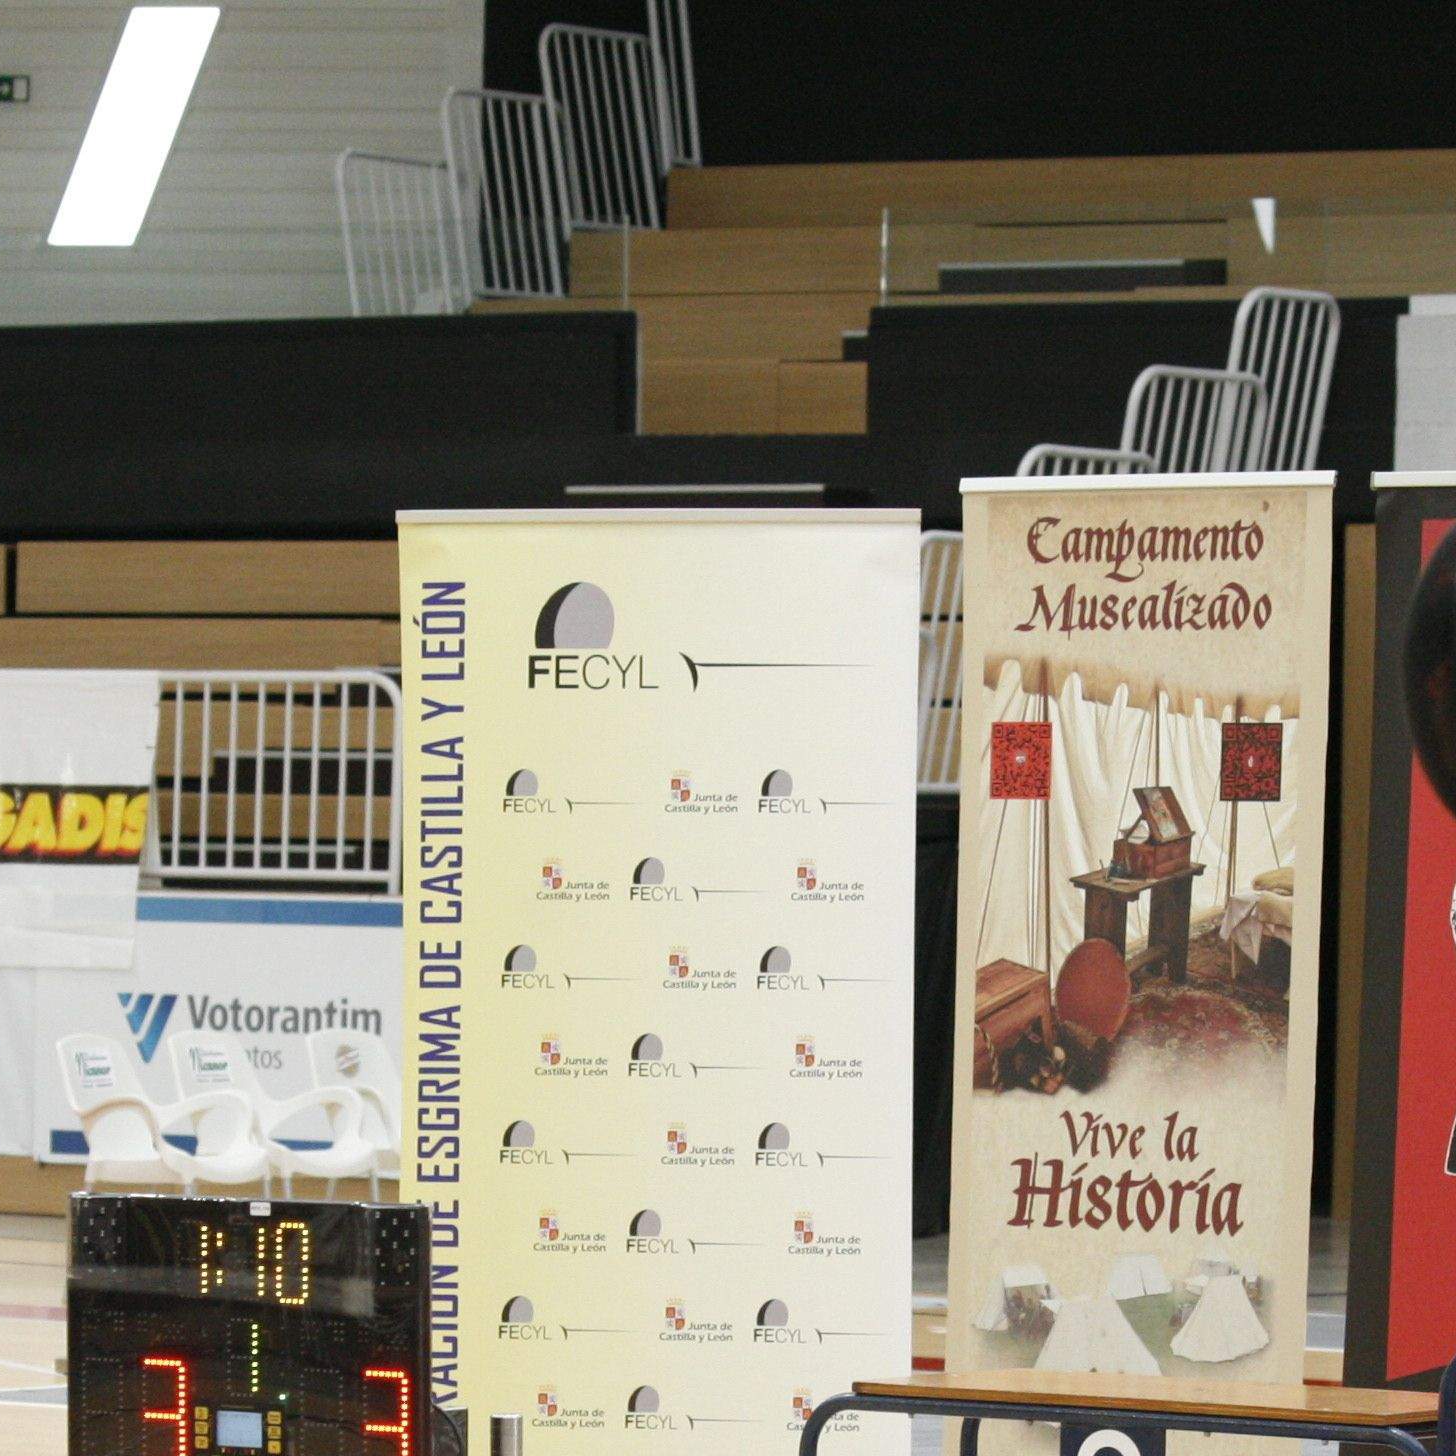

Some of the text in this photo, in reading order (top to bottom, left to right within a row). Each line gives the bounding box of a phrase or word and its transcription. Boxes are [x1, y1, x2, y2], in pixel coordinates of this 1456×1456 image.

[1025, 514, 1264, 583] Campamento
[1013, 578, 1273, 642] Musealizado
[412, 580, 466, 681] LEÓN
[527, 654, 659, 690] FECYL
[420, 695, 465, 722] Y
[502, 798, 557, 814] FECYL
[693, 793, 739, 803] Junta de
[757, 798, 811, 814] FECYL
[664, 803, 739, 813] Castilla León
[418, 735, 465, 925] CASTILLA
[565, 881, 610, 890] Junta de
[820, 882, 865, 891] Junta de
[535, 891, 610, 901] Castilla León
[629, 886, 683, 902] FECYL
[790, 892, 865, 902] Castilla León
[418, 939, 463, 990] DE
[500, 973, 555, 989] FECYL
[691, 970, 737, 978] Junta de
[662, 979, 737, 989] Castilla León
[756, 974, 810, 991] FECYL
[186, 993, 382, 1036] Votorantim
[563, 1056, 608, 1066] Junta de
[817, 1059, 862, 1068] Junta de
[534, 1066, 608, 1077] Castilla León
[627, 1062, 682, 1078] FECYL
[789, 1068, 863, 1079] Castilla León
[416, 1004, 462, 1183] ESGRIMA
[1058, 1109, 1200, 1163] Vive la
[499, 1148, 553, 1165] FECYL
[690, 1146, 735, 1155] Junta de
[660, 1155, 735, 1166] Castilla León
[754, 1151, 808, 1167] FECYL
[1006, 1151, 1245, 1237] Historia
[561, 1233, 606, 1242] Junta de
[816, 1235, 862, 1245] Junta de
[532, 1242, 607, 1252] Castilla León
[625, 1238, 679, 1254] FECYL
[787, 1245, 862, 1255] Castilla León
[199, 1220, 310, 1306] 1:10
[498, 1324, 552, 1341] FECYL
[687, 1323, 733, 1331] Junta de
[658, 1332, 734, 1342] Castilla León
[752, 1327, 805, 1344] FECYL
[560, 1408, 605, 1418] Junta de
[531, 1418, 606, 1428] Castilla León
[624, 1414, 677, 1430] FECYL
